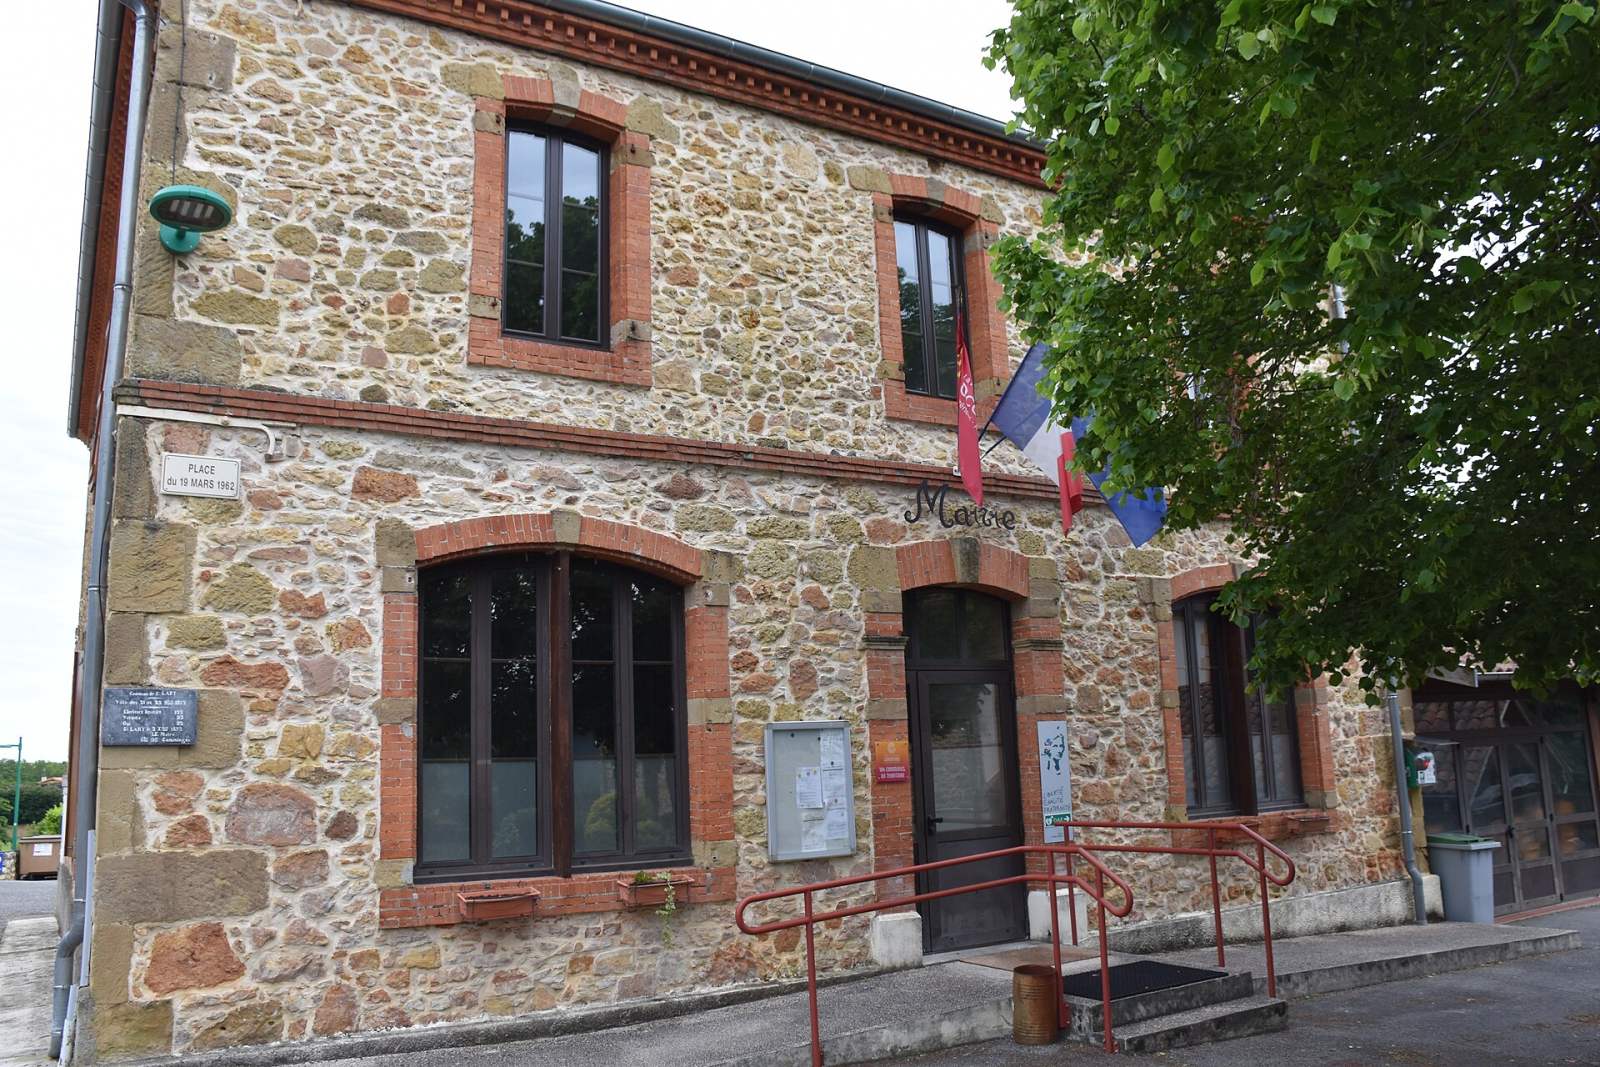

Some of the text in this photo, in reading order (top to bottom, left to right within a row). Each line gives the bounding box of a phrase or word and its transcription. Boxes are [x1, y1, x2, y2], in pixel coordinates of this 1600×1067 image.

[188, 463, 216, 475] PLACE
[167, 476, 235, 491] du 19 MARS 1962
[904, 479, 1016, 531] Mairie
